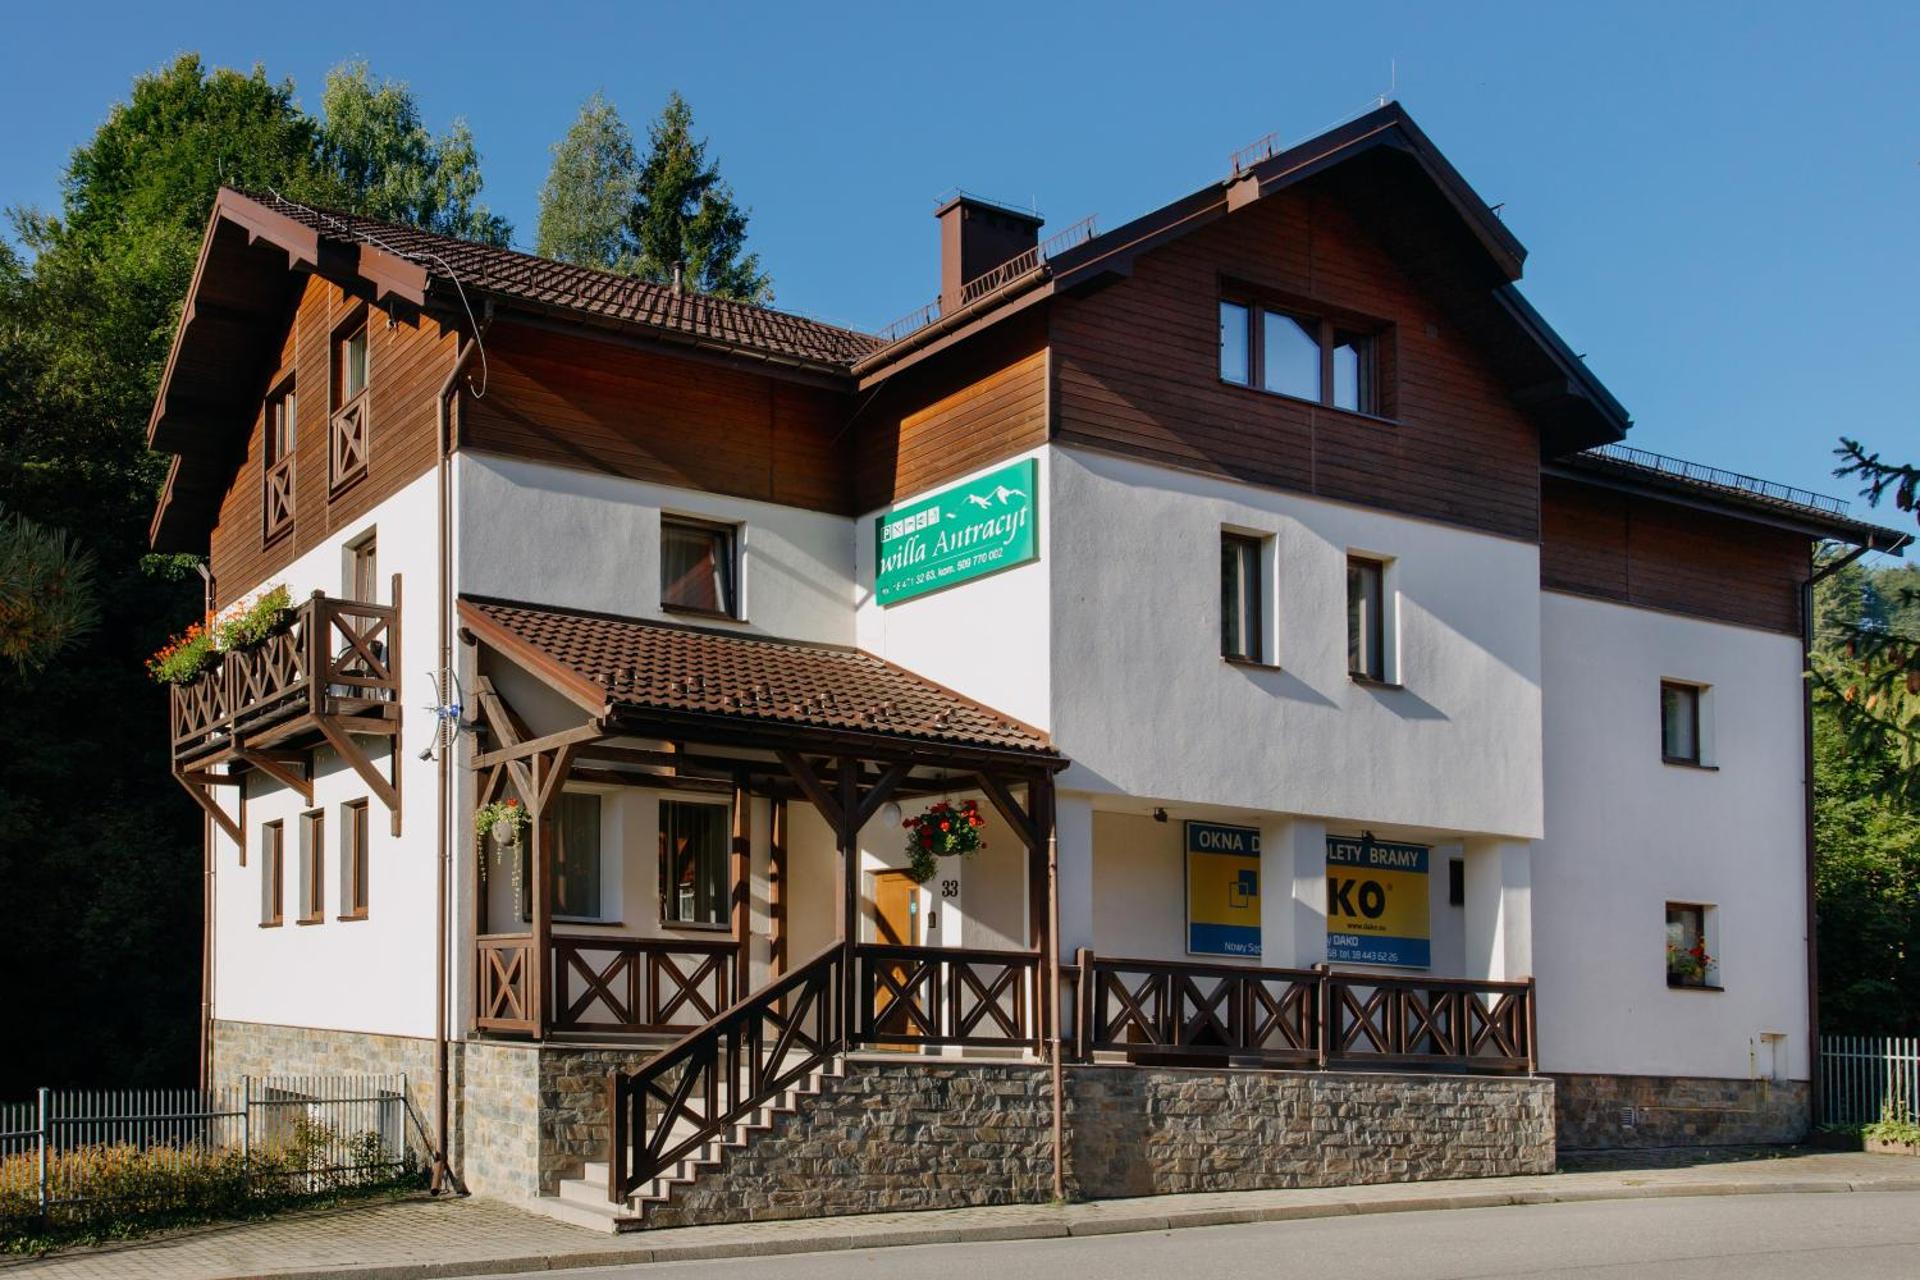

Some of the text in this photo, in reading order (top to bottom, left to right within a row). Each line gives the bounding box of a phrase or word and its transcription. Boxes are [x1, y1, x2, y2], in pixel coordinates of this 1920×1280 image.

[881, 505, 1028, 574] willa Antracyt
[1200, 831, 1243, 851] OKNA
[1370, 847, 1418, 867] BRAMY
[942, 880, 958, 897] 33
[1333, 934, 1358, 947] DAKO
